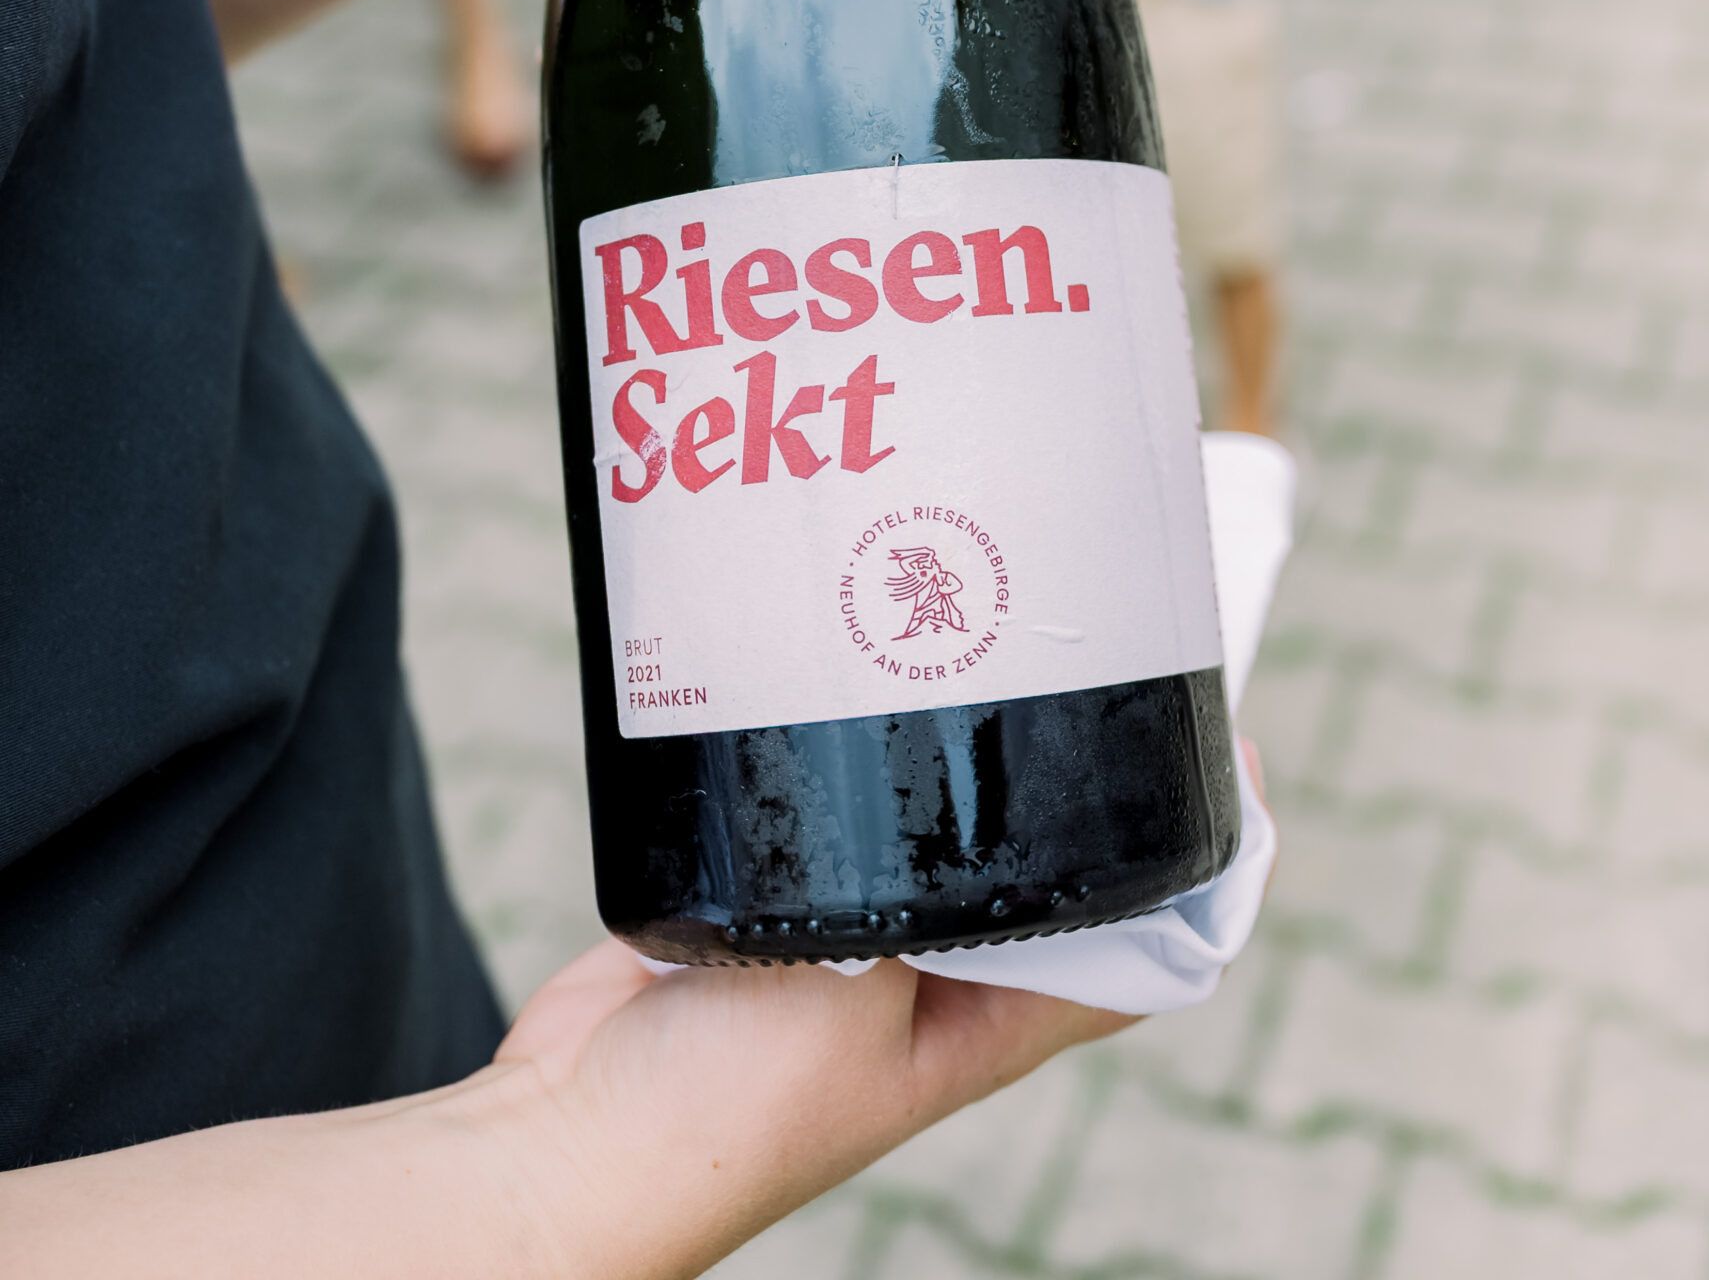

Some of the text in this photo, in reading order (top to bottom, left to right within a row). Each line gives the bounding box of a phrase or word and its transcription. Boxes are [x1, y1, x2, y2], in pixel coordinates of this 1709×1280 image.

[594, 221, 1091, 367] Riesen.
[610, 350, 897, 504] Sekt
[852, 506, 1010, 615] HOTEL RIESENGEBIRGE
[625, 637, 662, 657] BRUT
[627, 664, 661, 683] 2021
[839, 575, 997, 681] NEUHOF AN DER ZENN
[629, 687, 707, 709] FRANKEN
